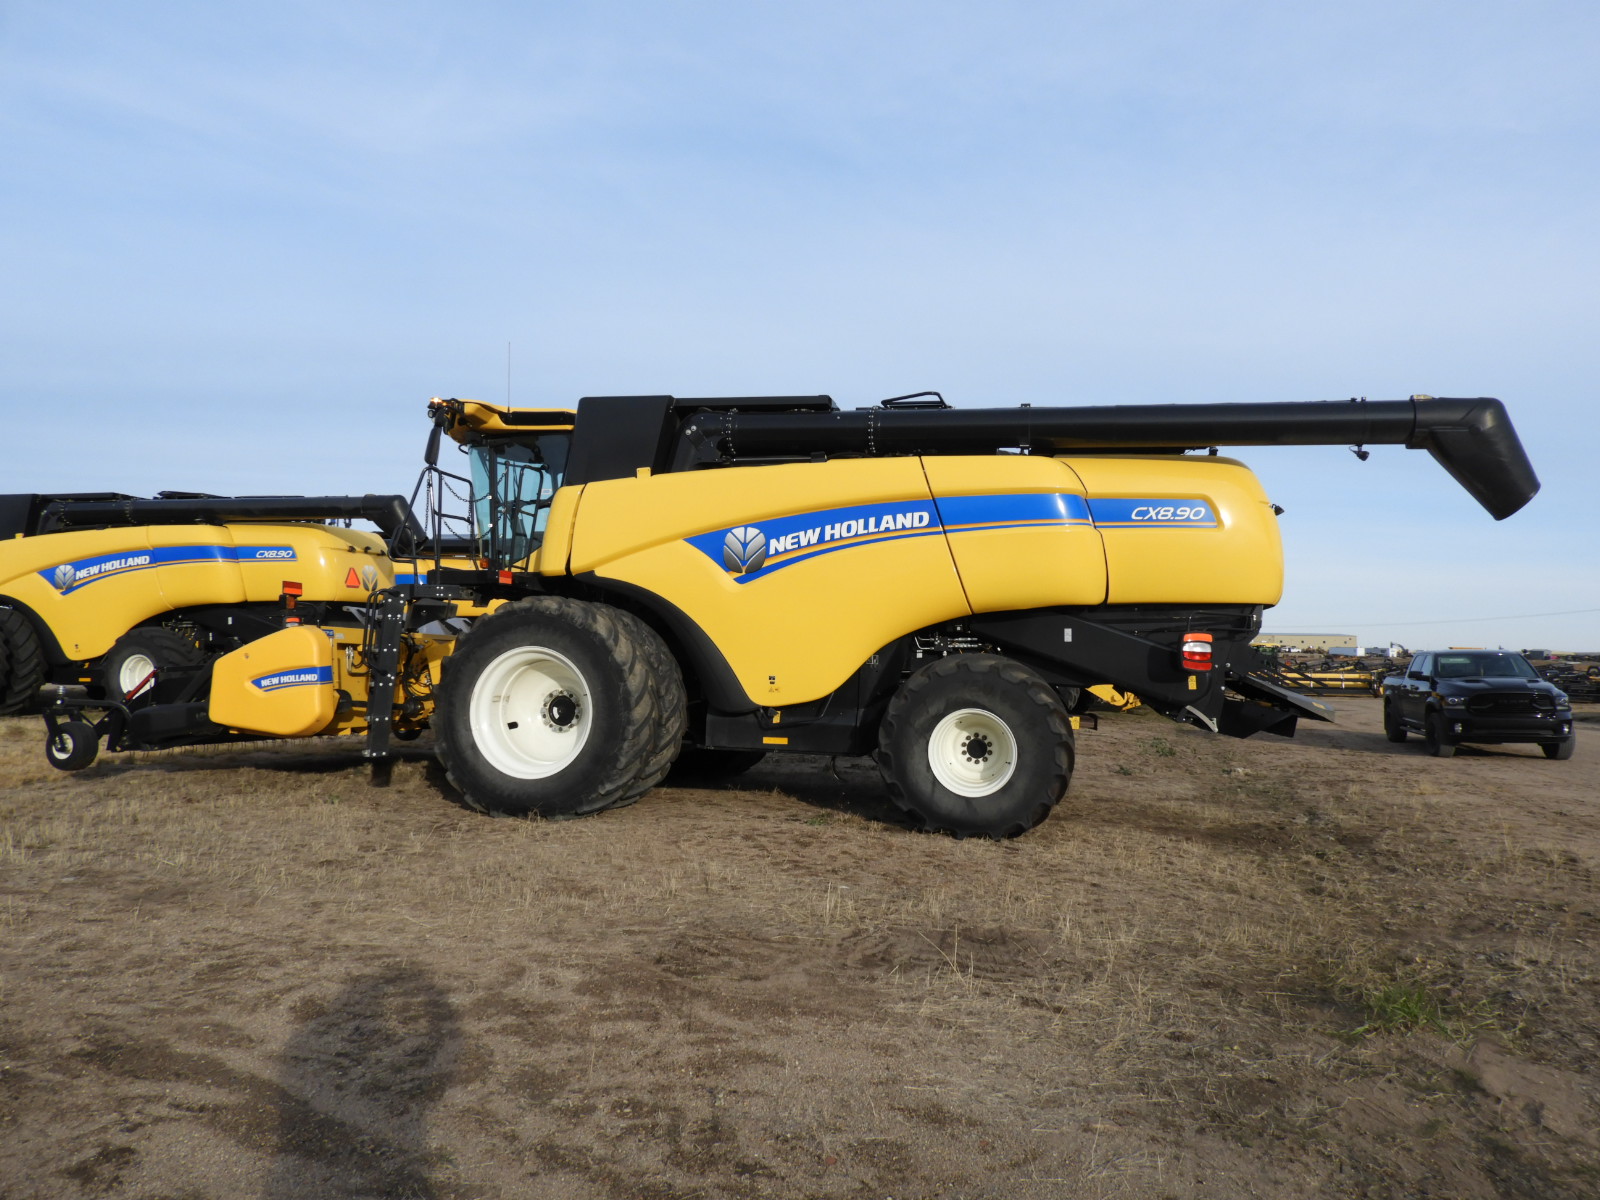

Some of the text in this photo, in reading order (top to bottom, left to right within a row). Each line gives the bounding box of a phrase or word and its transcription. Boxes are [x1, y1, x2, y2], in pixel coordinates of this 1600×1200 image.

[1131, 506, 1206, 520] CX8.90
[769, 511, 930, 555] NEW HOLLAND
[75, 555, 150, 581] NEW HOLLAND
[260, 673, 318, 687] NEW HOLLAND
